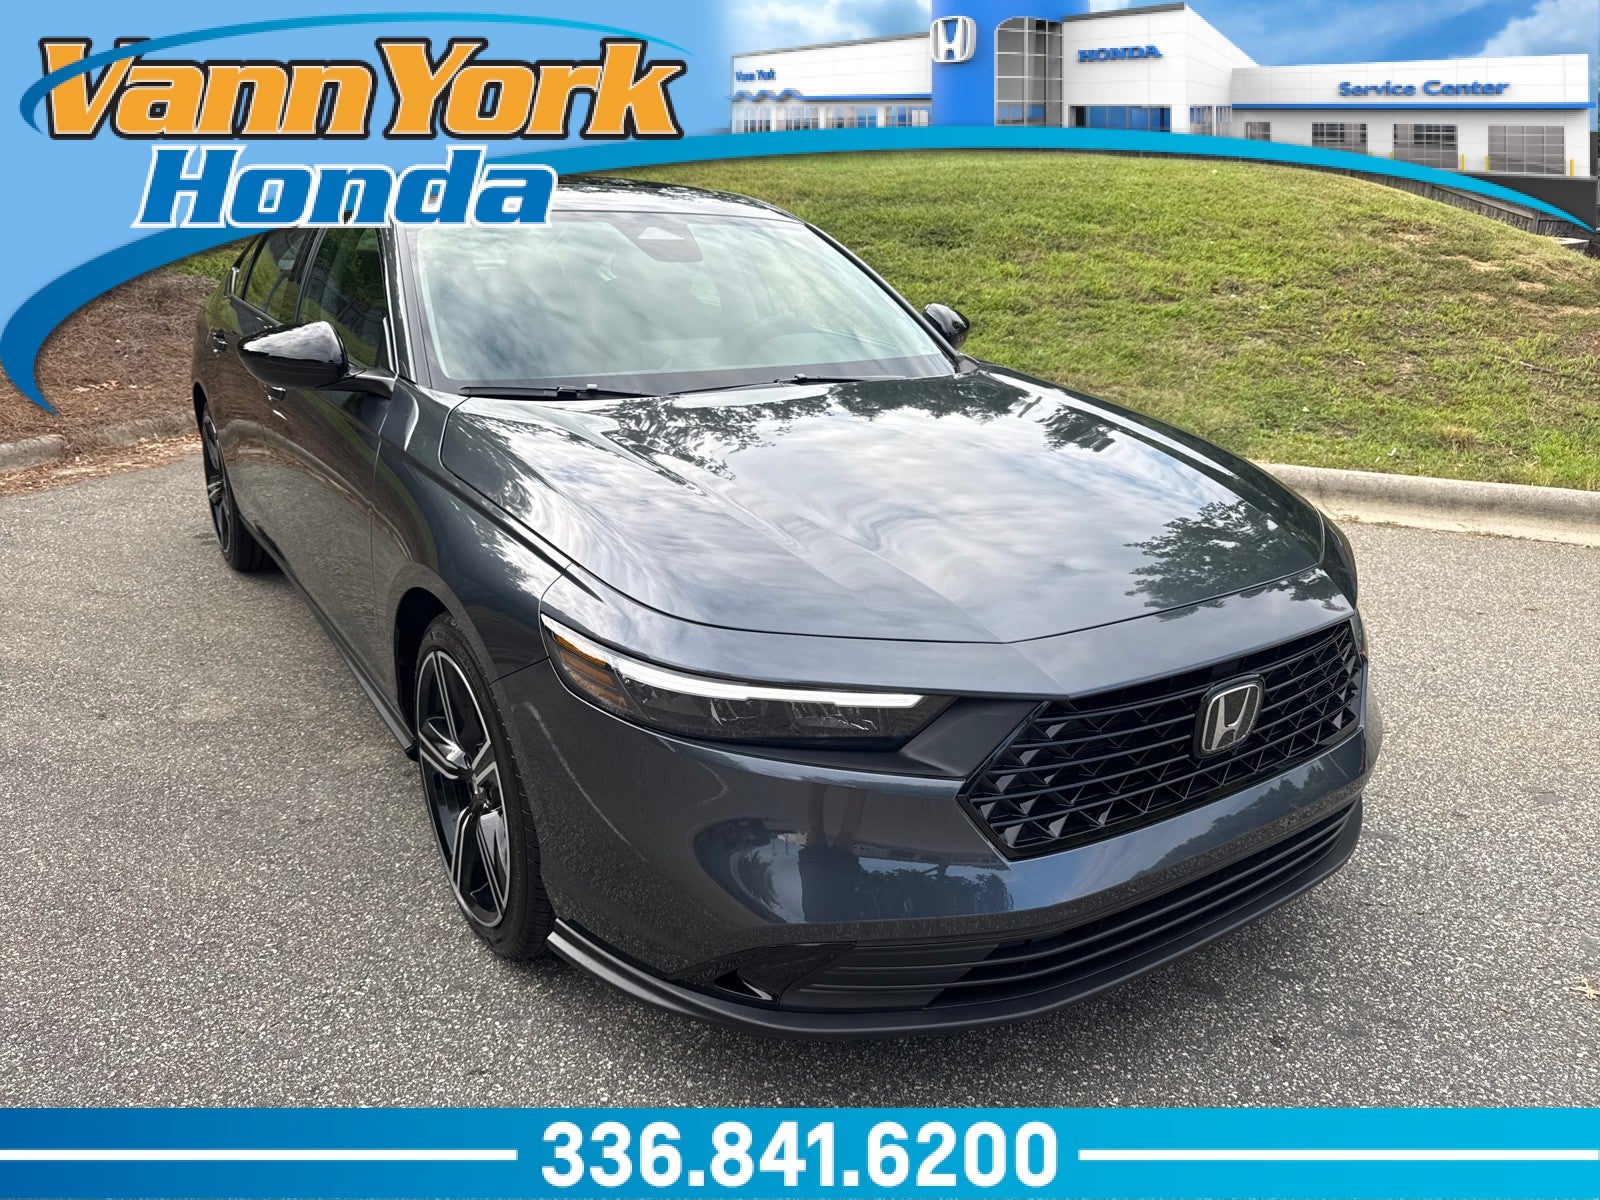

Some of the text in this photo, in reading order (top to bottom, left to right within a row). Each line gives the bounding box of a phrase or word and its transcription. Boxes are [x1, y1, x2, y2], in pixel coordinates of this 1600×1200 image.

[1077, 45, 1163, 63] HONDA
[1338, 79, 1511, 97] Service Center
